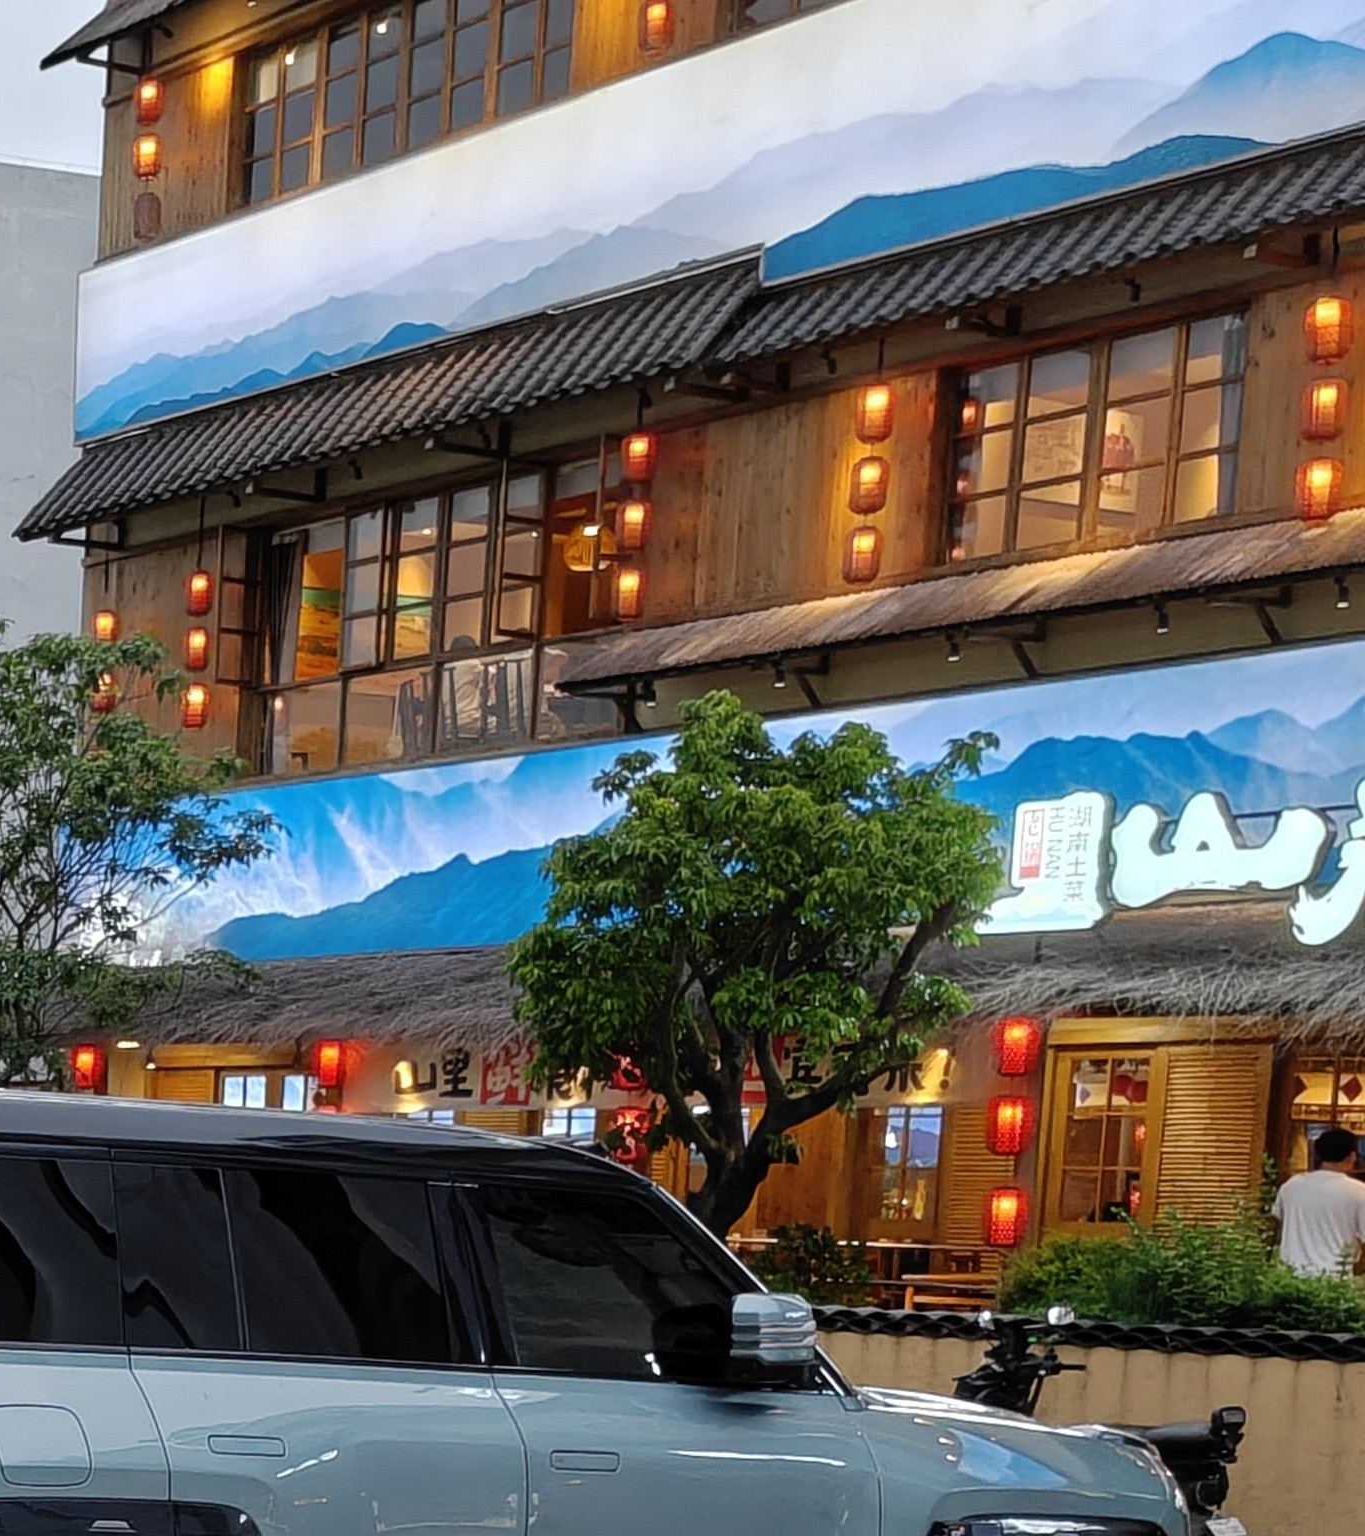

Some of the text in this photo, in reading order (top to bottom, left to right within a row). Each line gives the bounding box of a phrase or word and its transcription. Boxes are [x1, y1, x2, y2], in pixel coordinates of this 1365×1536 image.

[1044, 806, 1065, 880] HU NAN
[1061, 805, 1093, 903] 湖南土菜
